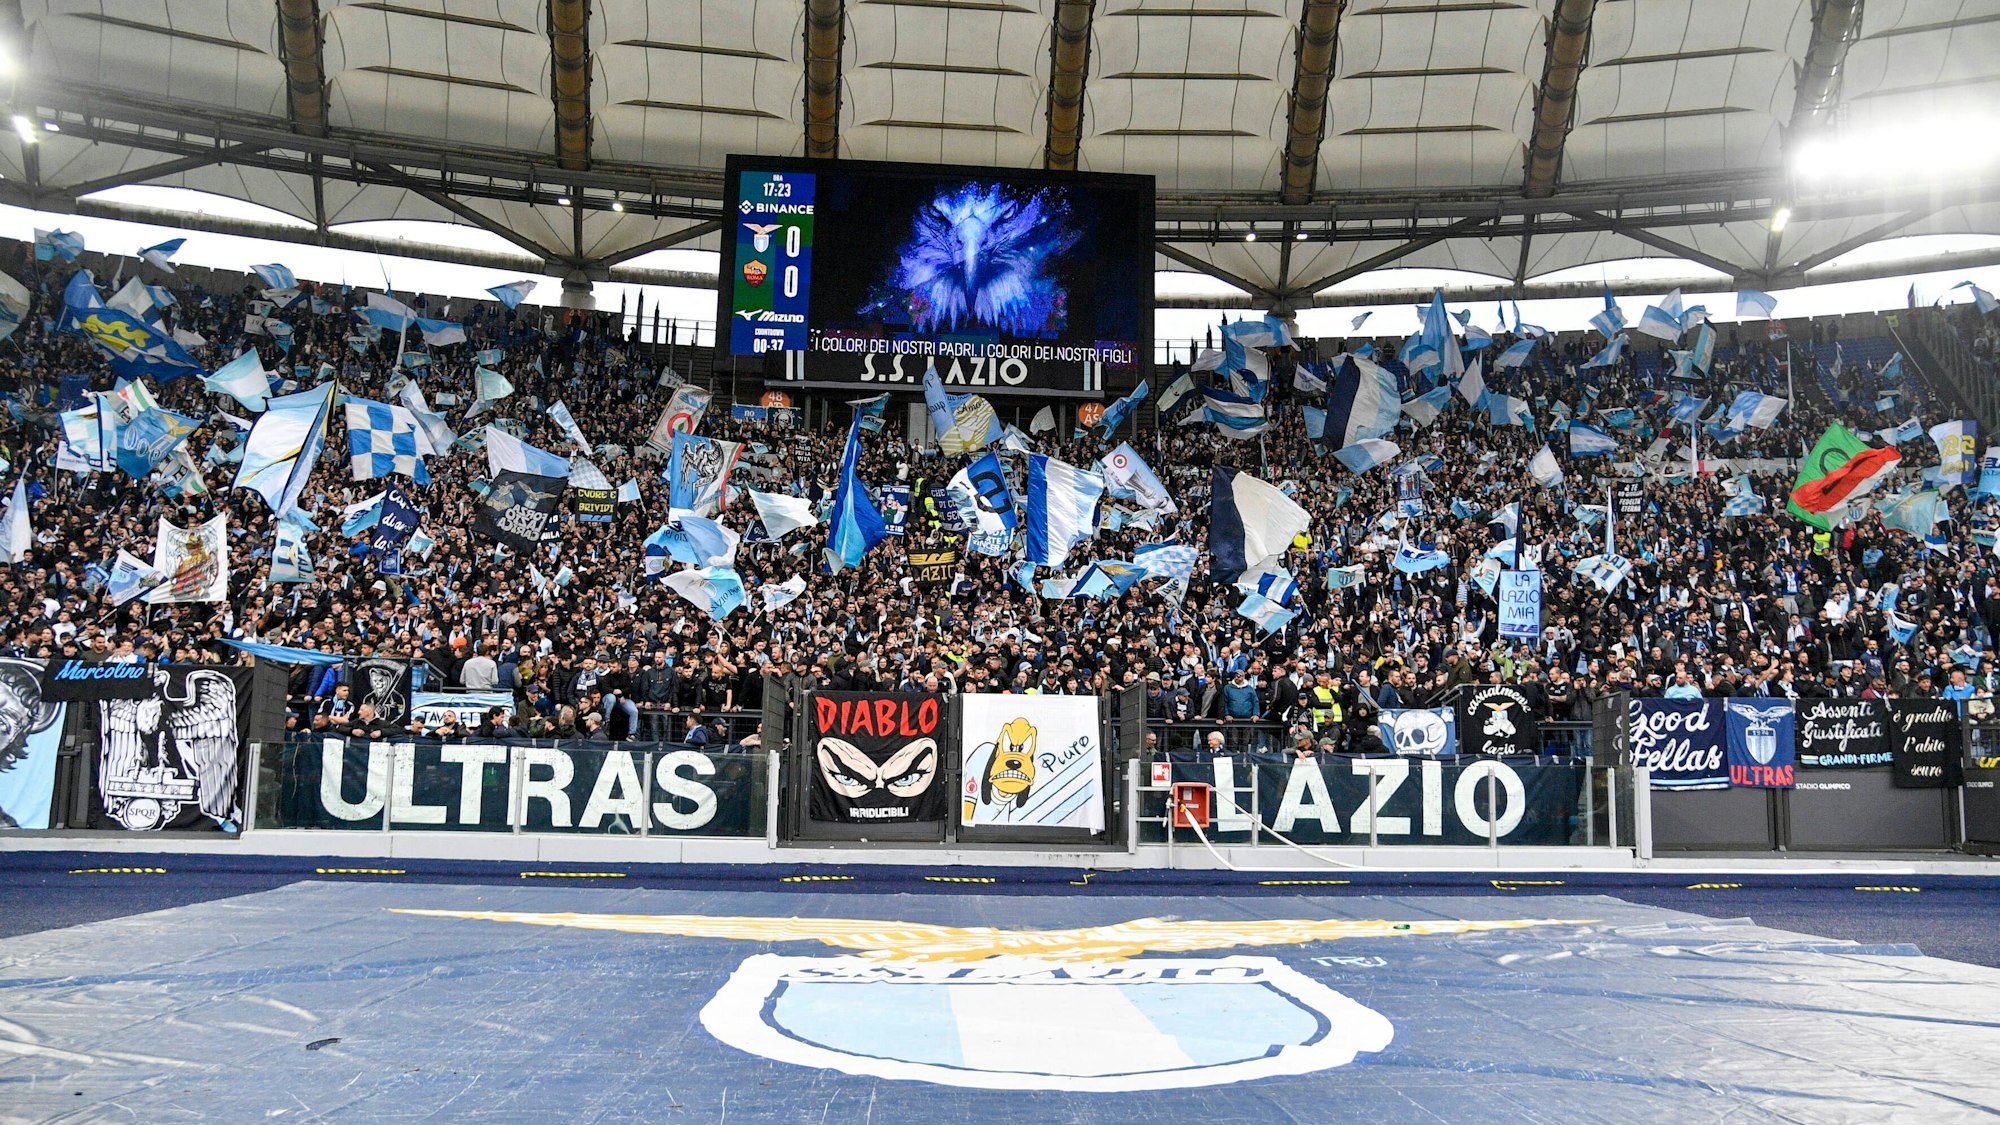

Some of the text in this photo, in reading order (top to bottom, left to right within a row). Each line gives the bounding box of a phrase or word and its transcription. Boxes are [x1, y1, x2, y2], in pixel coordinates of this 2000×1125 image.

[763, 182, 791, 197] 17:23
[756, 203, 815, 215] BINANCE
[786, 226, 801, 258] 0
[784, 265, 799, 298] 0
[815, 337, 1132, 363] I COLORI DEI NOSTRI PADRI. I COLORI DEI NOSTRI FIGLI
[860, 353, 914, 383] S.S.
[768, 391, 783, 401] 48
[1085, 403, 1099, 412] 47
[610, 490, 617, 499] E
[931, 489, 946, 497] CHE
[578, 503, 614, 512] BRIVIDI
[1515, 574, 1530, 587] LA
[1501, 589, 1540, 604] LAZIO
[1507, 606, 1535, 619] MIA
[54, 660, 145, 681] Marcolino
[1467, 684, 1532, 716] casualmente
[815, 696, 938, 737] DIABLO
[1802, 701, 1875, 720] Assenti
[1901, 705, 1953, 733] gradito
[1616, 699, 1711, 741] Good
[1801, 719, 1884, 752] Giustificati
[1482, 740, 1516, 755] lazio
[1612, 735, 1724, 773] Fellas
[1818, 752, 1894, 766] GRANDI-FIRME
[1730, 764, 1795, 786] ULTRAS
[1910, 764, 1943, 777] scuro
[320, 738, 718, 830] ULTRAS
[1213, 756, 1526, 839] LAZIO
[128, 808, 156, 820] SPQR
[849, 807, 909, 818] IRRIDUCIBILI
